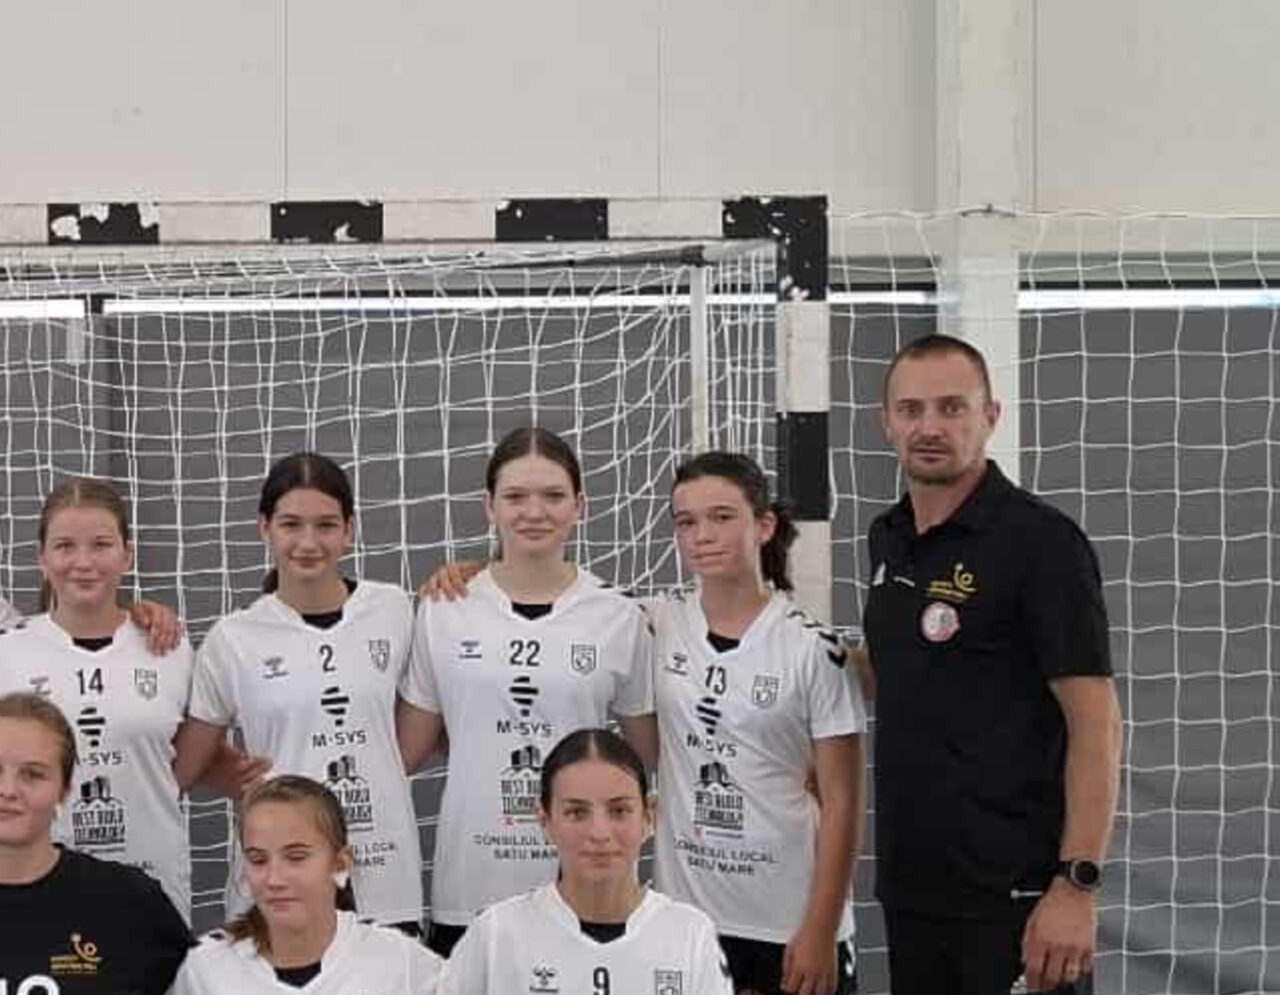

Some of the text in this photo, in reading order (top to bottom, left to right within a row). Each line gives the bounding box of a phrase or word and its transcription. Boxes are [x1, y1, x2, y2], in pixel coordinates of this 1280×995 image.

[319, 644, 336, 672] 2
[509, 640, 541, 667] 22
[77, 668, 104, 695] 14
[705, 664, 727, 695] 13
